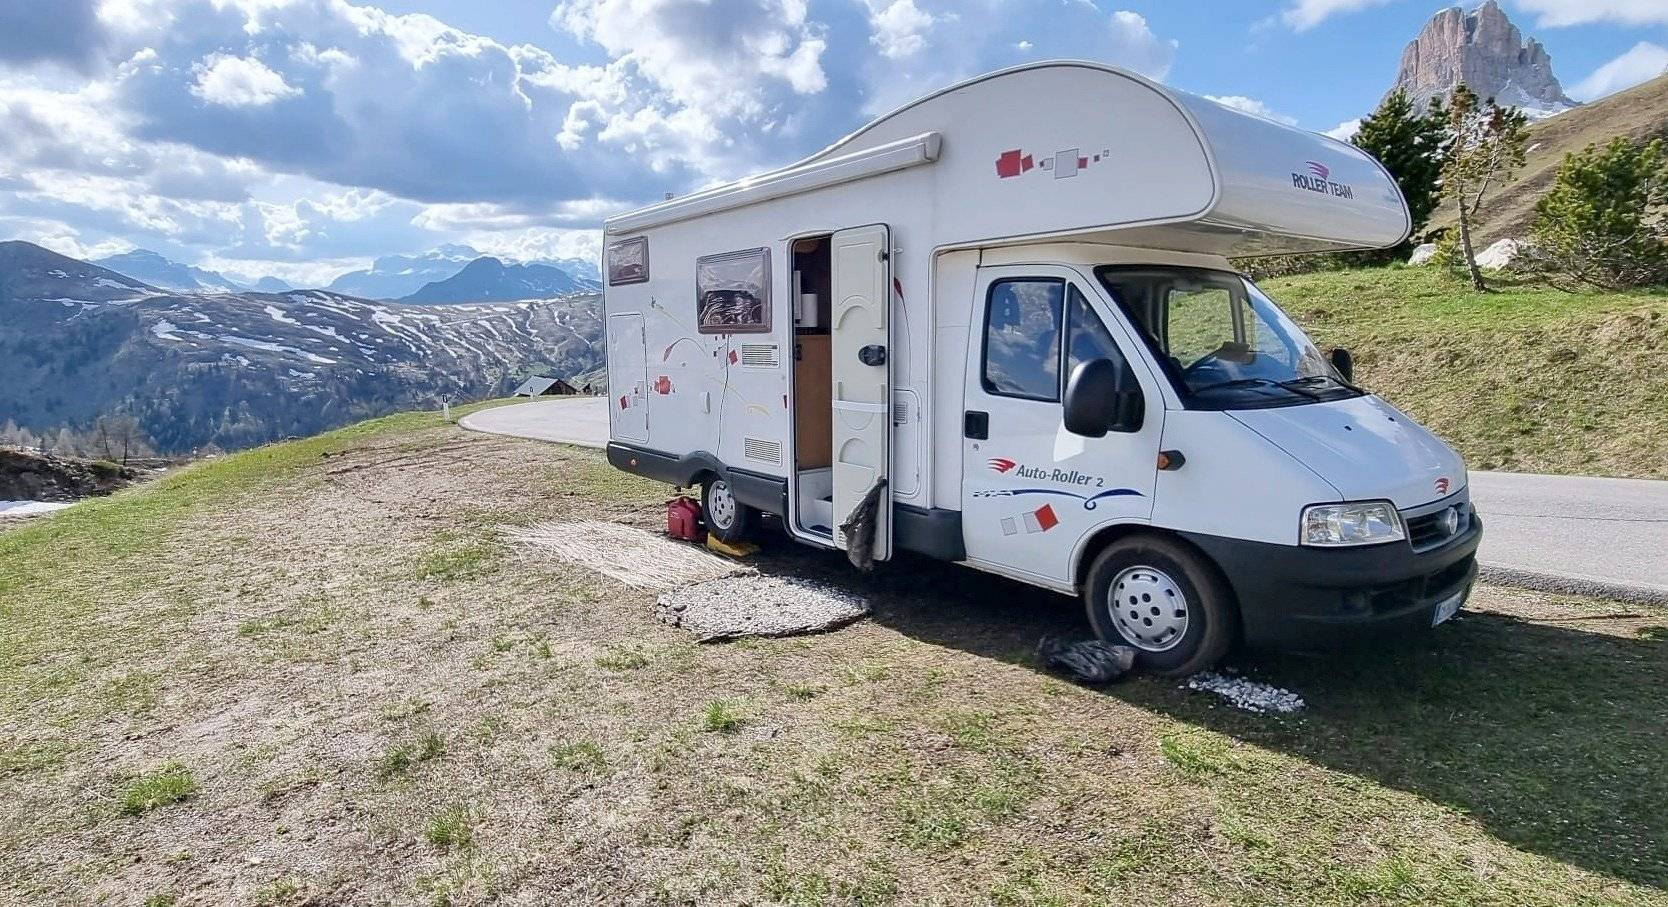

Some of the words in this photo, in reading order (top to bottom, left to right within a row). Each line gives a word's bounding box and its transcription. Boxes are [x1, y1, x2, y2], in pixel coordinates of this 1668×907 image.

[1291, 173, 1329, 194] ROLLER
[1328, 181, 1354, 200] TEAM
[1016, 465, 1092, 486] Auto-Roller
[1096, 478, 1104, 487] 2
